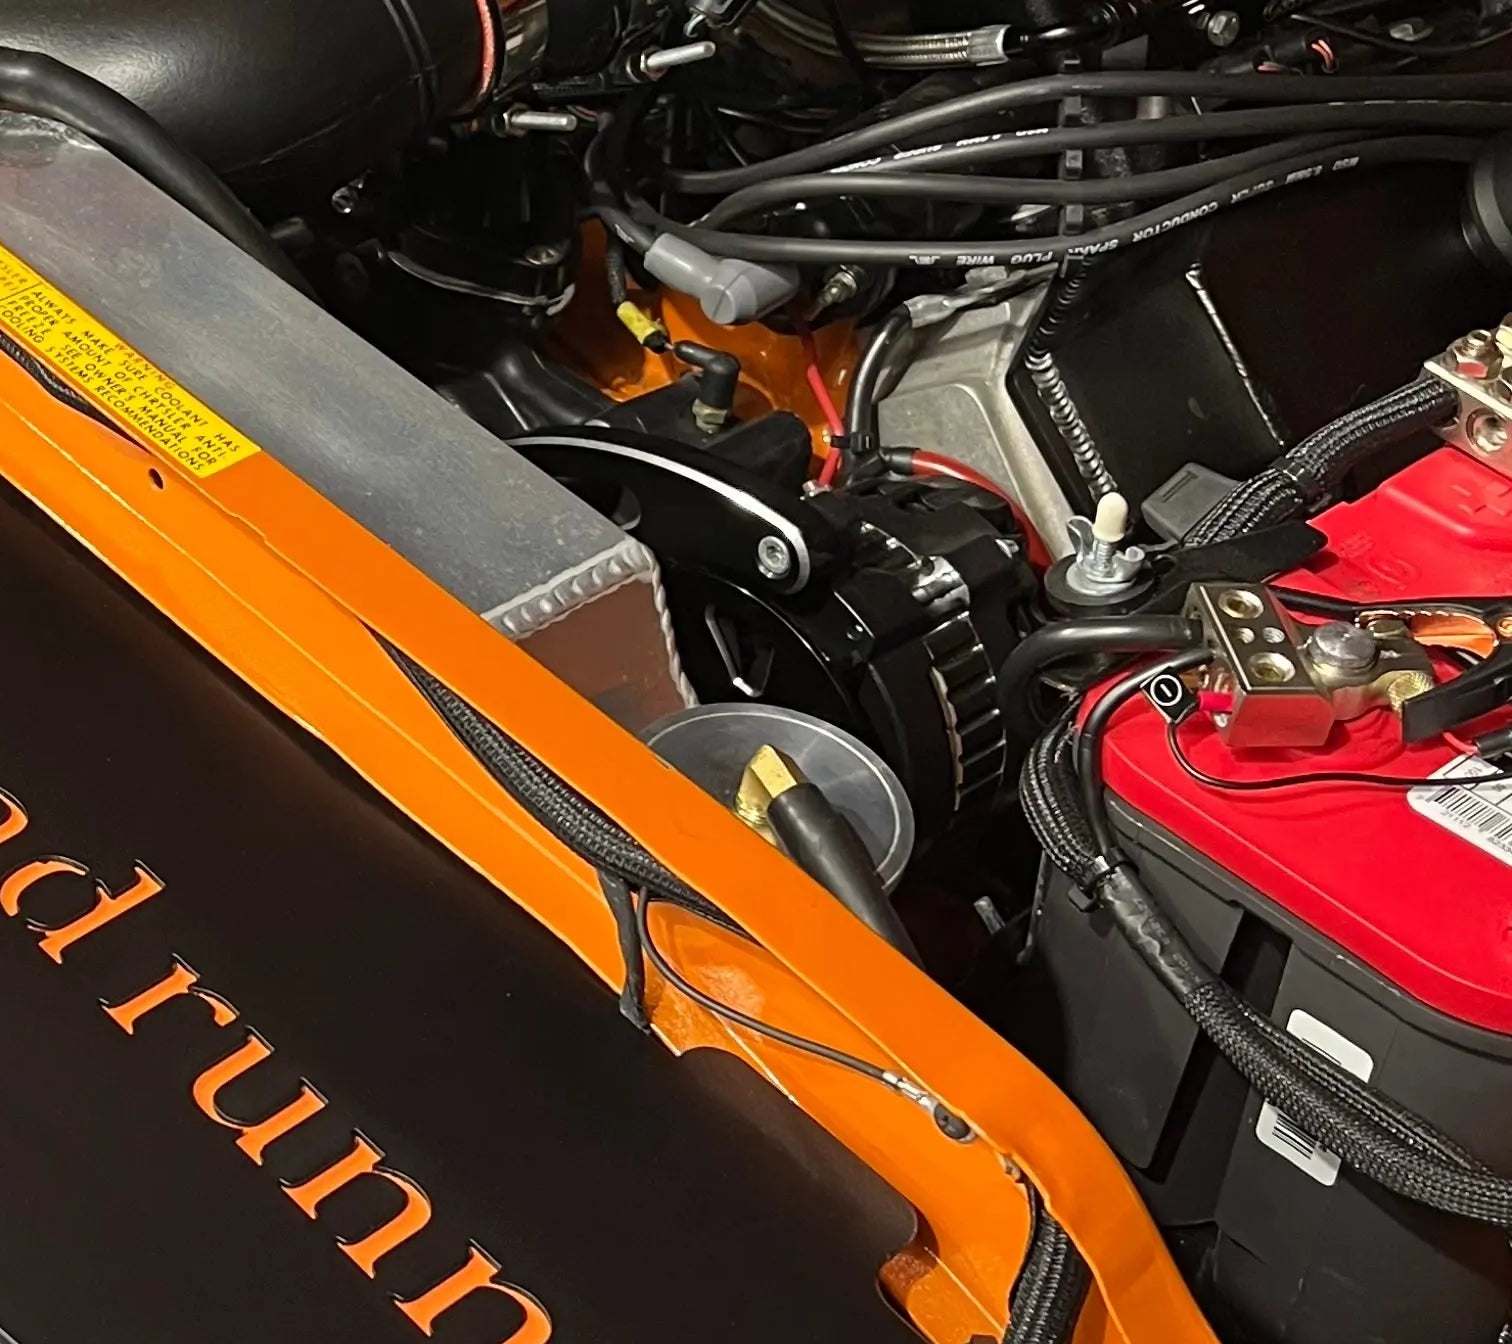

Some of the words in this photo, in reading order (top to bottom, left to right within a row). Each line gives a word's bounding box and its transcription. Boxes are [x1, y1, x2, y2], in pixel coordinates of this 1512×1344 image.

[956, 254, 996, 266] WIRE
[1010, 250, 1053, 265] PLUG
[1132, 201, 1218, 243] CONDUCTOR
[17, 294, 59, 326] PROPER
[61, 329, 111, 368] AMOUNT
[113, 370, 131, 384] OF
[131, 384, 191, 431] CHRYSLER
[30, 289, 76, 325] ALWAYS
[81, 329, 114, 355] MAKE
[118, 358, 147, 381] SURE
[153, 385, 207, 428] COOLANT
[213, 432, 241, 454] HAS
[60, 343, 82, 360] SEE
[83, 361, 135, 403] OWNER'S
[137, 404, 188, 444] MANUAL
[189, 445, 217, 467] FOR
[113, 342, 176, 391] WARNING
[45, 345, 94, 384] SYSTEMS
[93, 383, 205, 472] RECOMMENDATIONS
